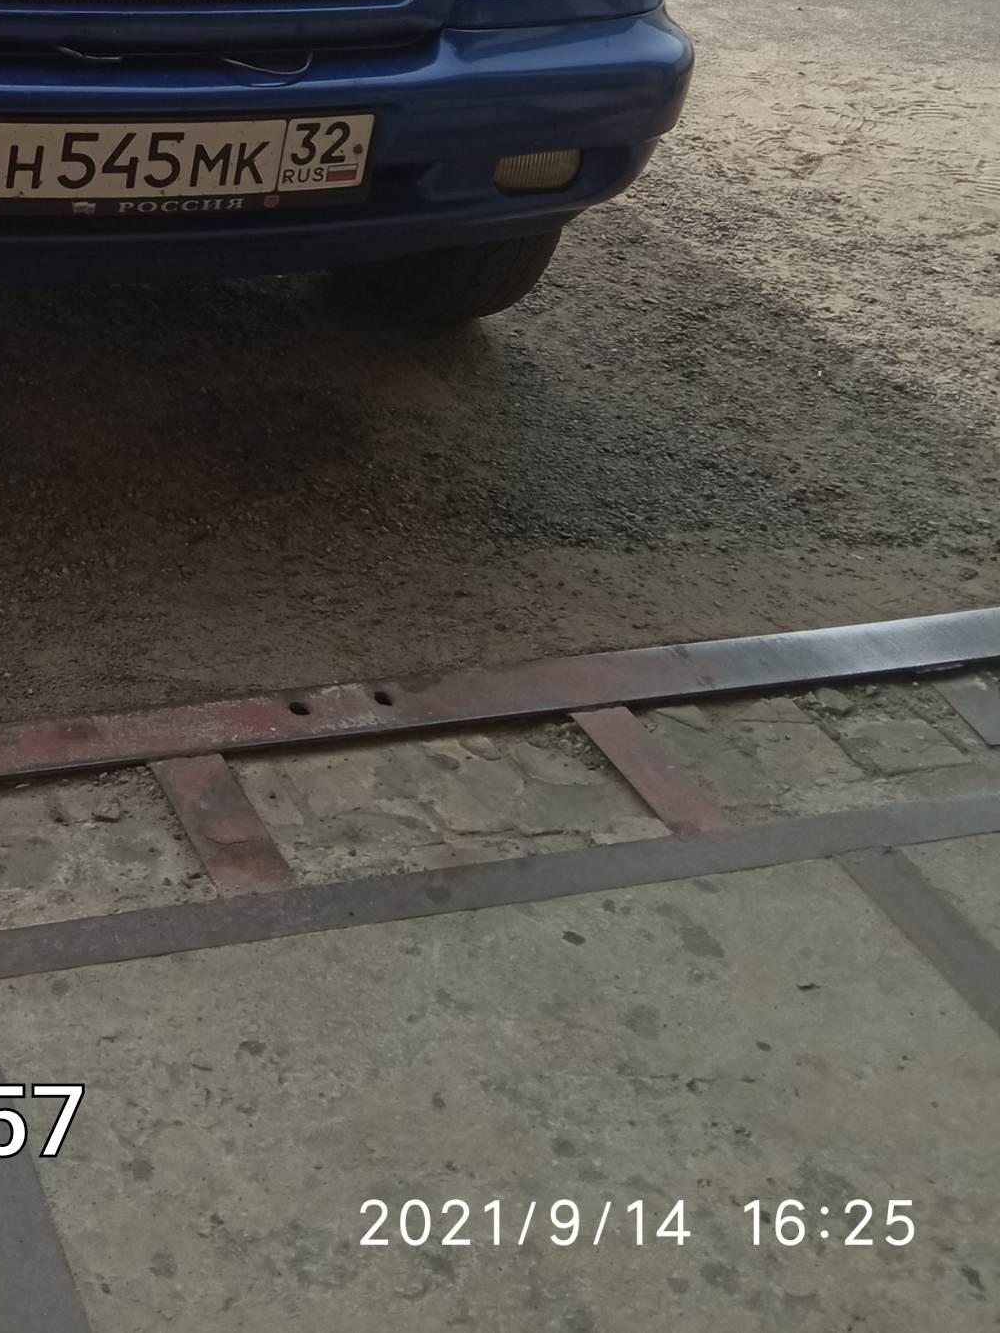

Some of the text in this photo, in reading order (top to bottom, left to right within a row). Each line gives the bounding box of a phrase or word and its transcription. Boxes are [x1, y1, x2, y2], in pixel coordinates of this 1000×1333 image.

[290, 120, 351, 166] 32
[281, 167, 325, 184] RUS
[118, 197, 244, 213] РОССИЯ
